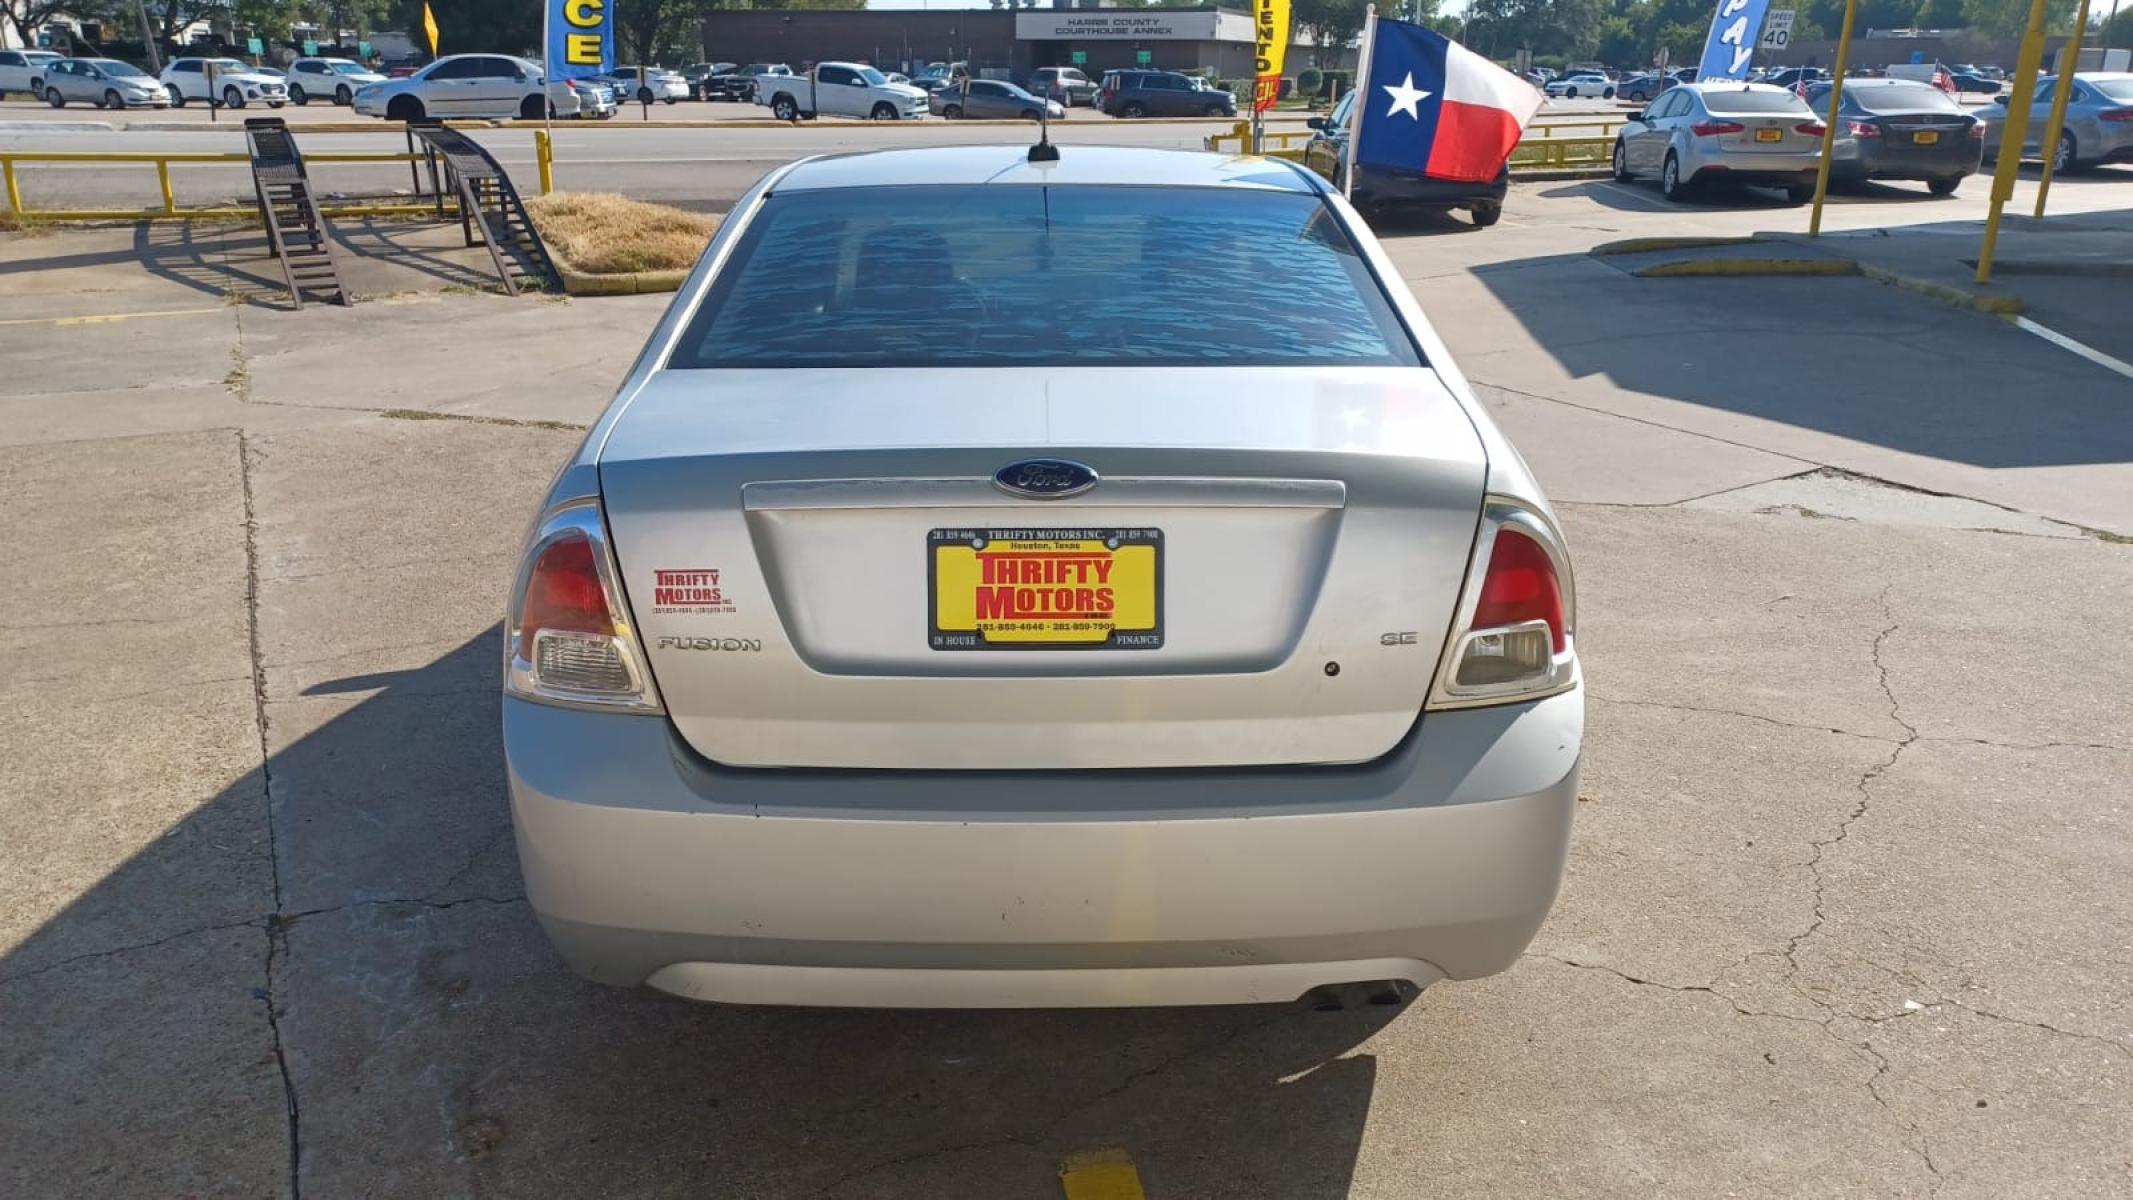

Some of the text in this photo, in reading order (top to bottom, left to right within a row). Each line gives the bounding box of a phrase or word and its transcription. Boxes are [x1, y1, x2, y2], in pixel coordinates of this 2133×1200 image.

[1068, 18, 1160, 26] HARRIS COUNTY
[1770, 13, 1793, 21] SPEED
[1055, 27, 1173, 35] COURTHOUSE ANNEX
[1764, 30, 1788, 46] 40
[1017, 464, 1073, 488] Ford
[988, 530, 1037, 540] THRIFTY
[1037, 530, 1083, 540] MOTORS
[1010, 541, 1081, 550] Houston, Texas
[976, 552, 1114, 585] THRIFTY
[654, 569, 720, 586] THRIFTY
[655, 587, 722, 605] MOTORS
[976, 586, 1115, 619] MOTORS
[657, 636, 761, 652] FUSION
[933, 635, 976, 645] IN HOUSE
[1117, 635, 1160, 645] FINANCE
[1380, 631, 1419, 646] SE
